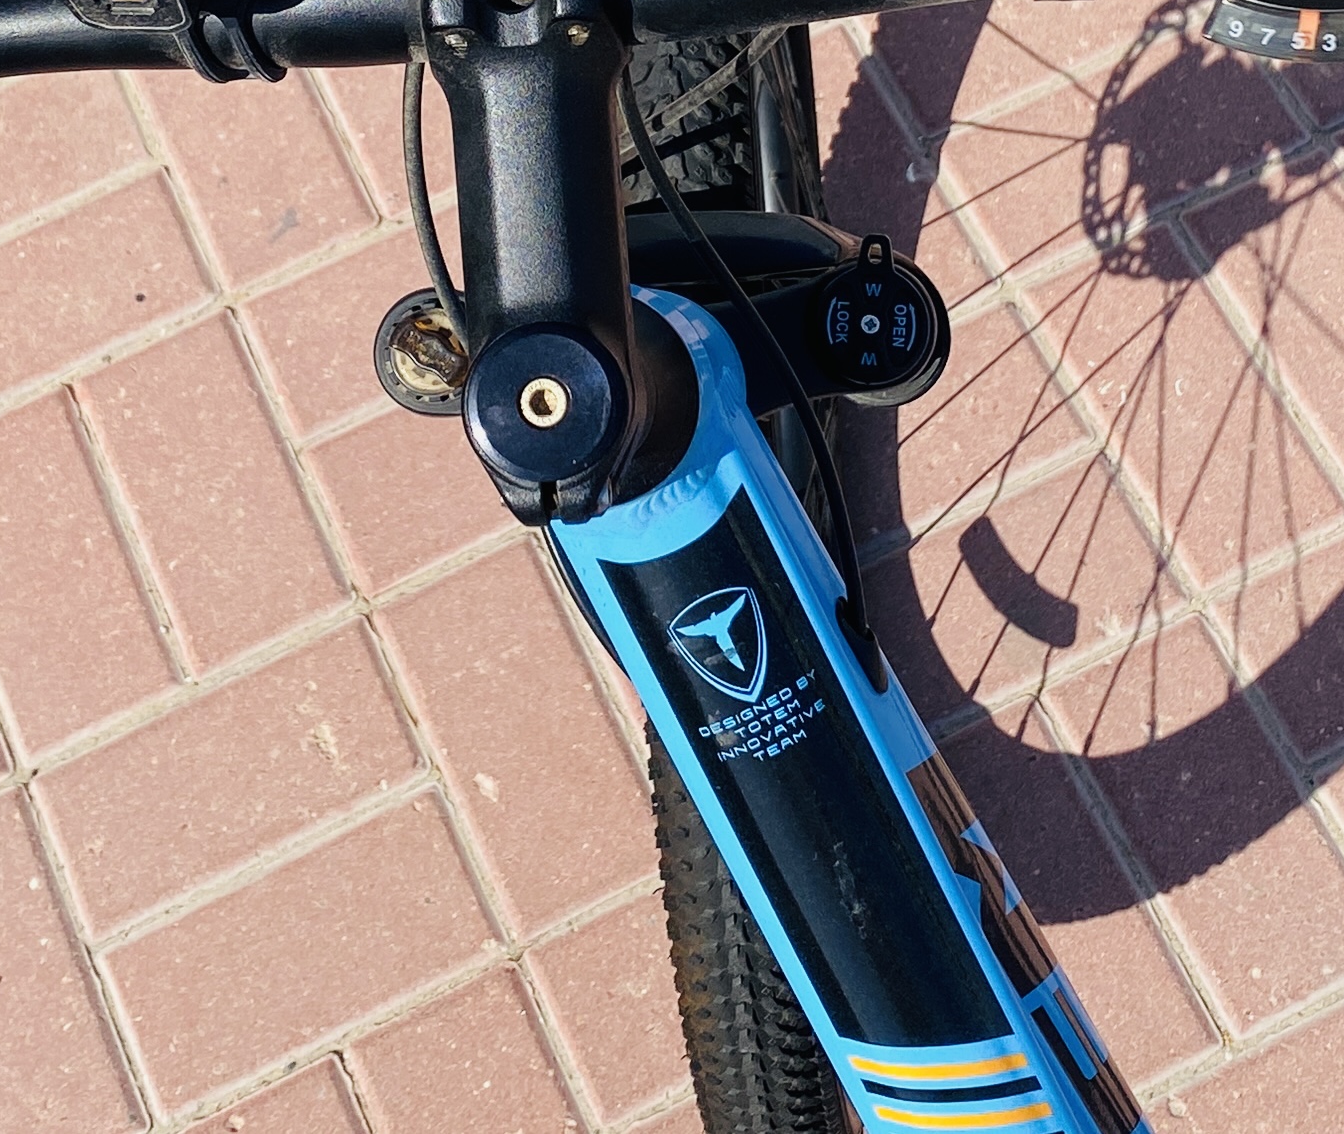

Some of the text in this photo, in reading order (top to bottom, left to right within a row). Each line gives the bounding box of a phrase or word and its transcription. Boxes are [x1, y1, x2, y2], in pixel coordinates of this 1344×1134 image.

[1228, 20, 1244, 38] 9
[1260, 28, 1276, 46] 7
[1290, 32, 1306, 50] 5
[1321, 33, 1338, 52] 3
[835, 301, 850, 343] LOCK
[892, 304, 907, 348] OPEN
[698, 668, 816, 738] DESIGNED BY
[734, 698, 801, 739] TOTEM
[717, 698, 826, 763] INNOVATIVE
[752, 728, 808, 762] TEAM
